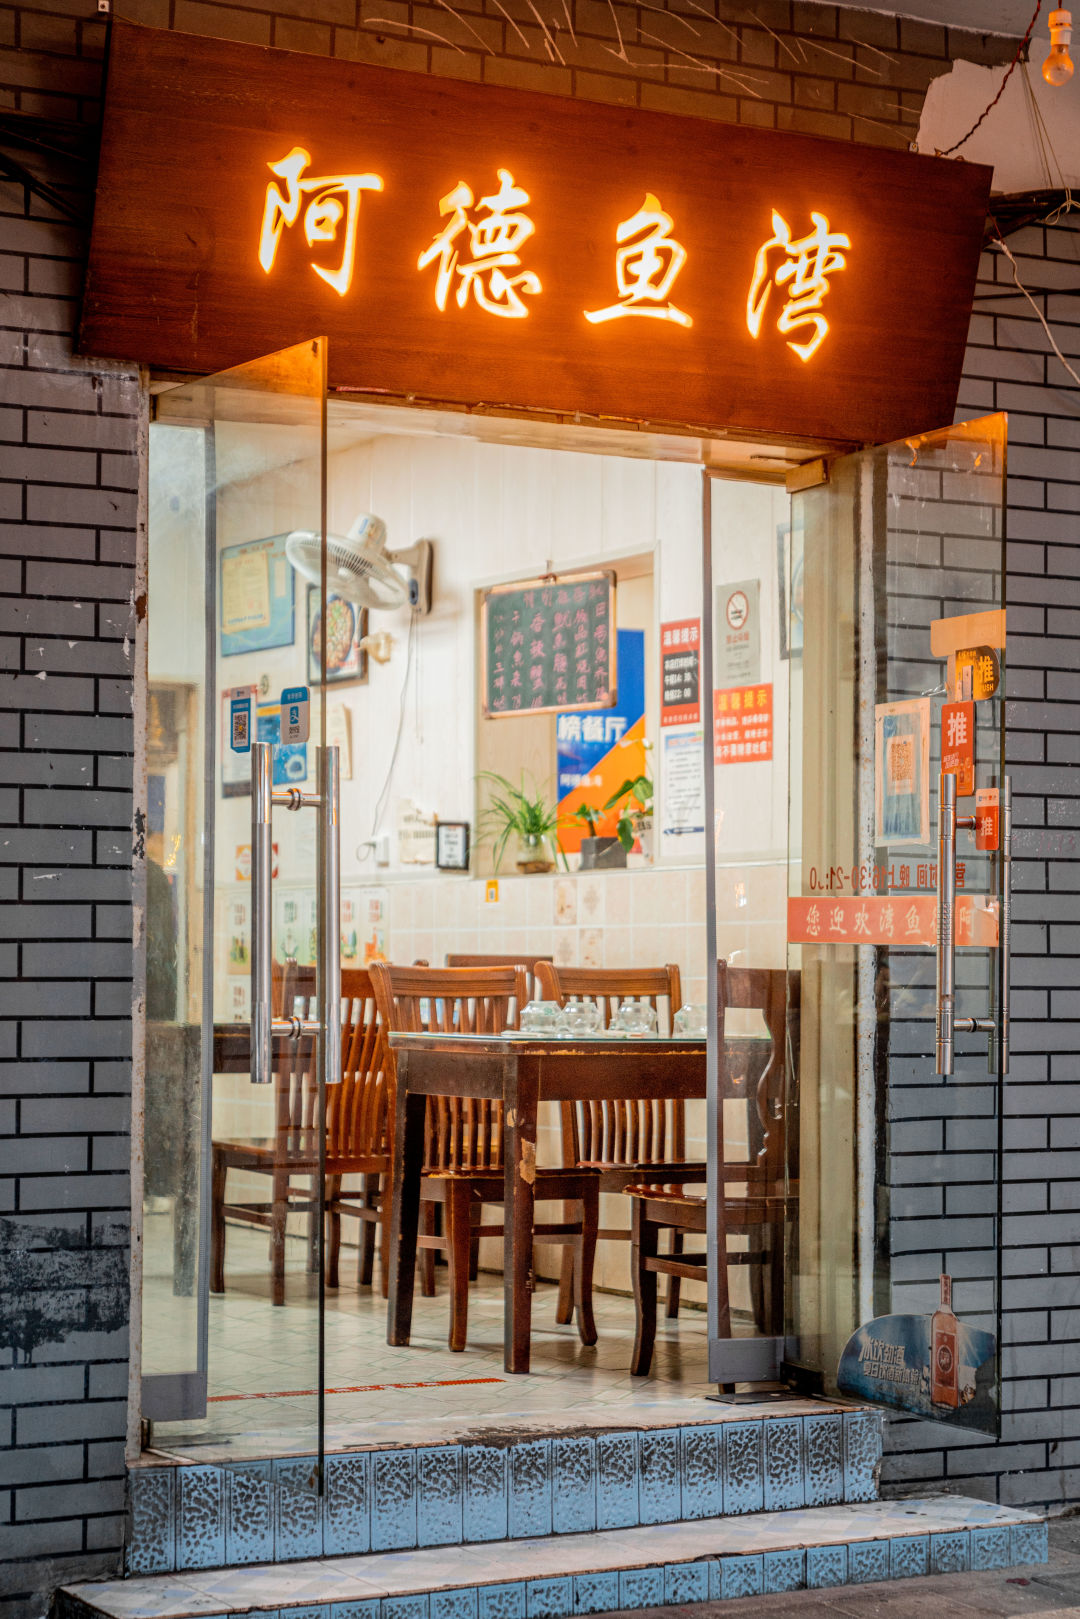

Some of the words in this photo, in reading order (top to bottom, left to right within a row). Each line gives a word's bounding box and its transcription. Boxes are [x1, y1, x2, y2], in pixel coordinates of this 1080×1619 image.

[257, 146, 852, 362] 阿德鱼湾
[663, 626, 698, 646] 温馨提示
[978, 655, 995, 683] 推
[718, 689, 768, 712] 温馨提示
[947, 710, 968, 747] 推
[979, 816, 994, 836] 推
